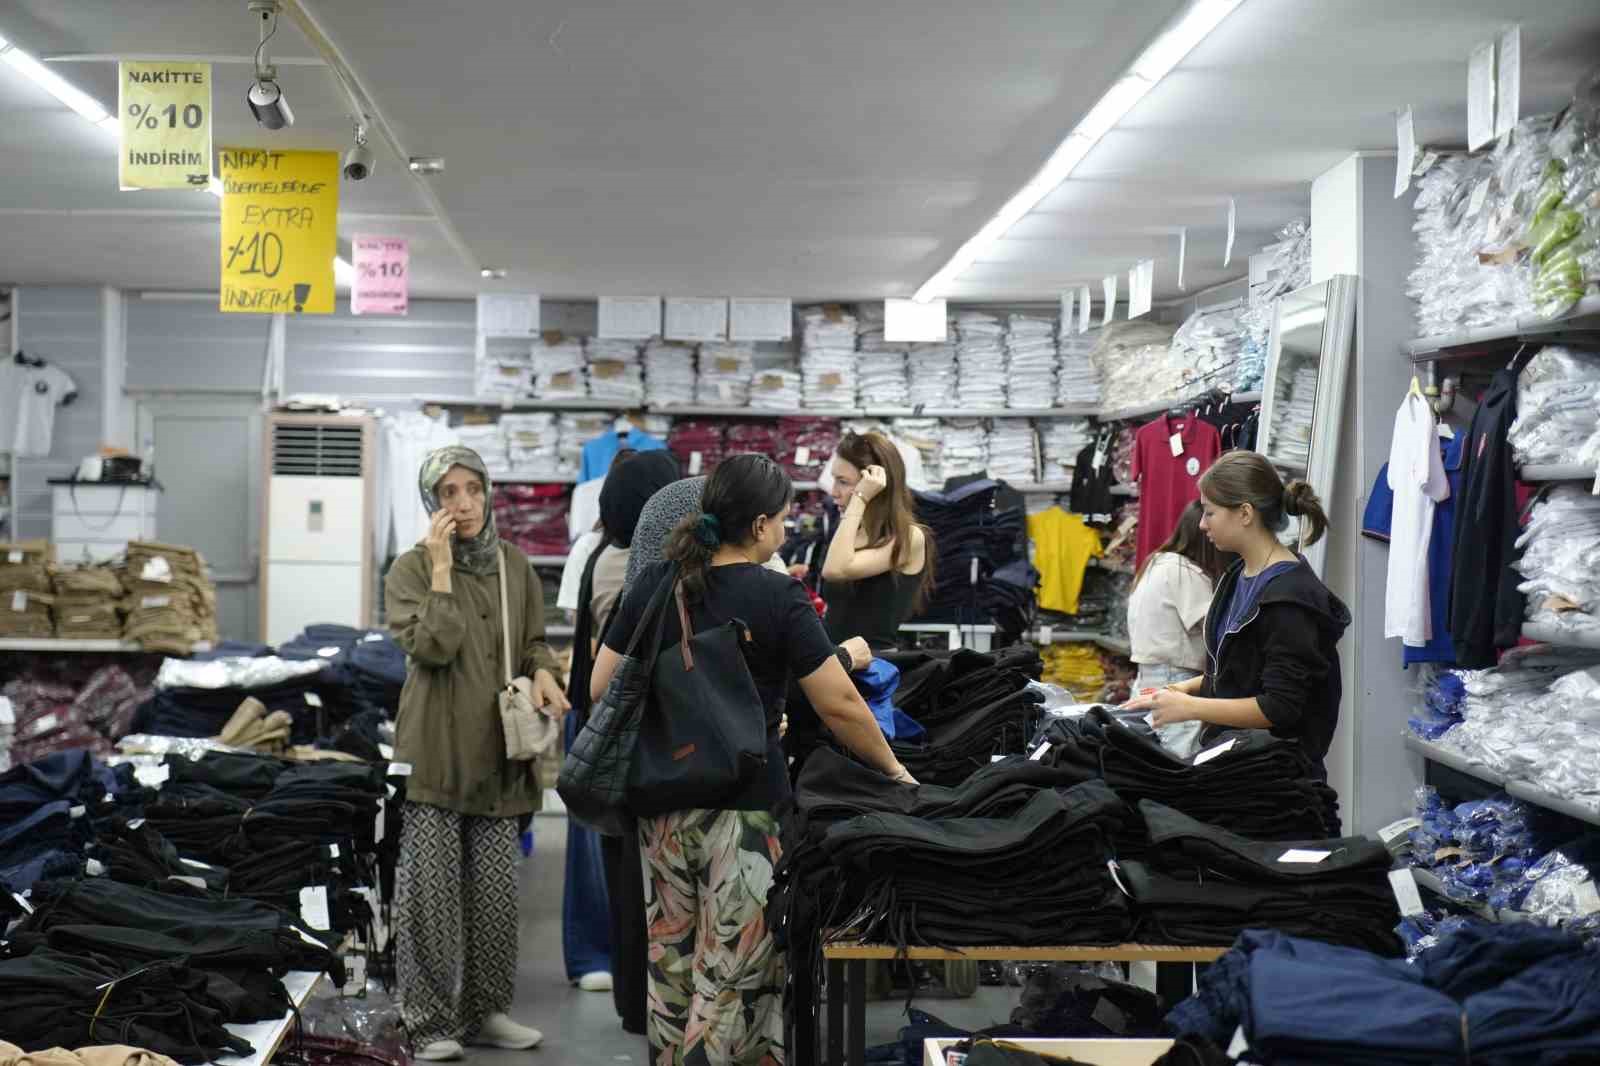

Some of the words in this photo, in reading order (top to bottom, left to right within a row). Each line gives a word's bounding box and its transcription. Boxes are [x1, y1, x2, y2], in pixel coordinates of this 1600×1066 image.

[128, 69, 204, 84] NAKİTTE
[128, 103, 203, 129] %10
[129, 148, 202, 165] İNDİRİM
[241, 204, 314, 229] EXTRA
[226, 231, 283, 278] %10
